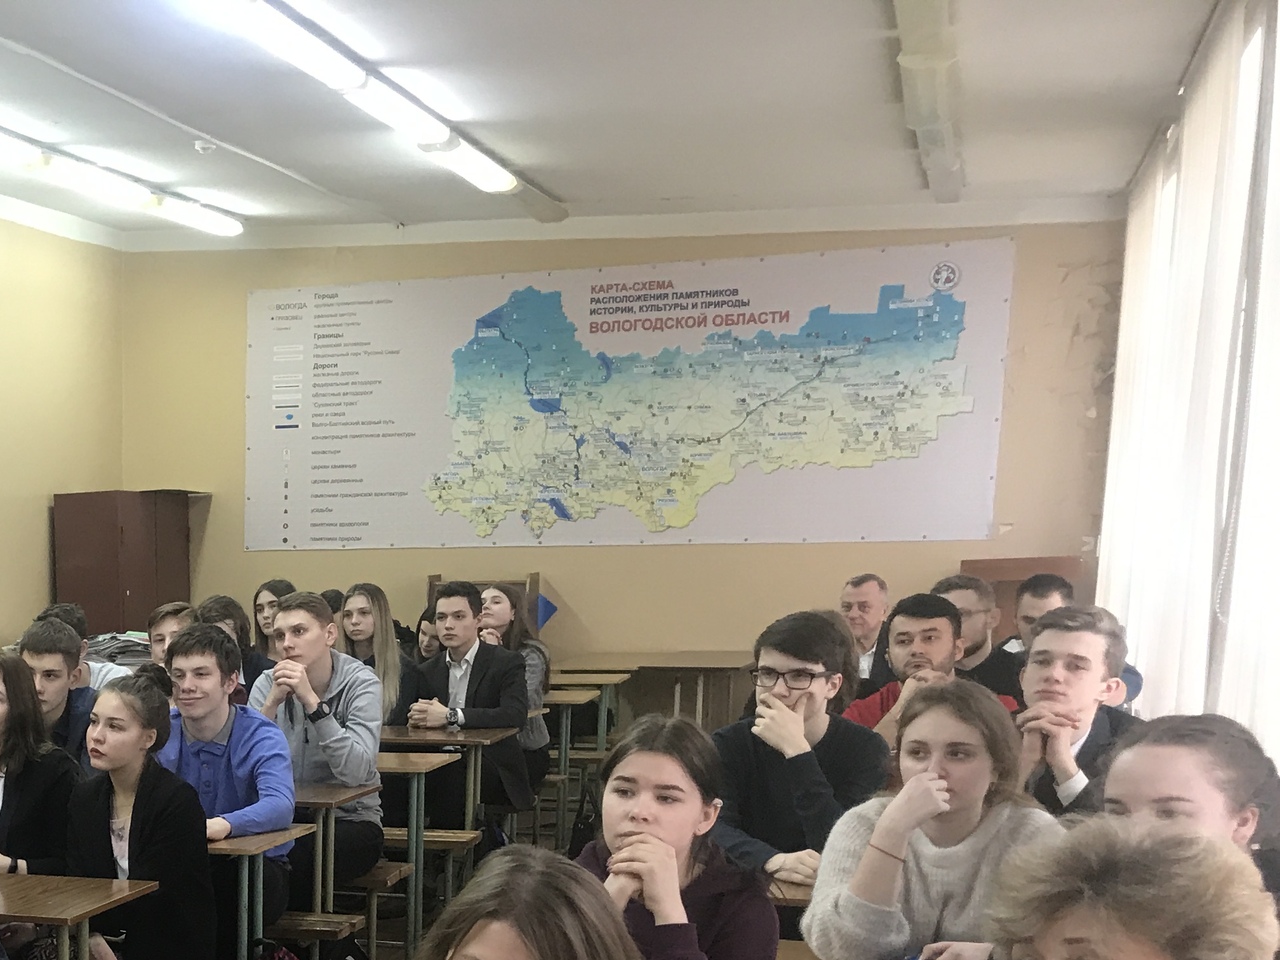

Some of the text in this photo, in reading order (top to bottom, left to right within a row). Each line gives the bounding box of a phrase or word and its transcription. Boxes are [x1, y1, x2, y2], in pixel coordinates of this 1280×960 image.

[590, 280, 674, 294] КАРТА-СХЕМА
[314, 292, 339, 300] Города
[590, 288, 739, 305] РАСПОЛОЖЕНИЯ ПАМЯТНИКОВ
[275, 302, 308, 310] ВОЛОГДА
[589, 298, 751, 316] ИСТОРИИ, КУЛЬТУРЫ И ПРИРОДЫ
[589, 310, 790, 334] ВОЛОГОДСКОЙ ОБЛАСТИ
[313, 332, 344, 341] Границы
[312, 362, 338, 370] Дороги
